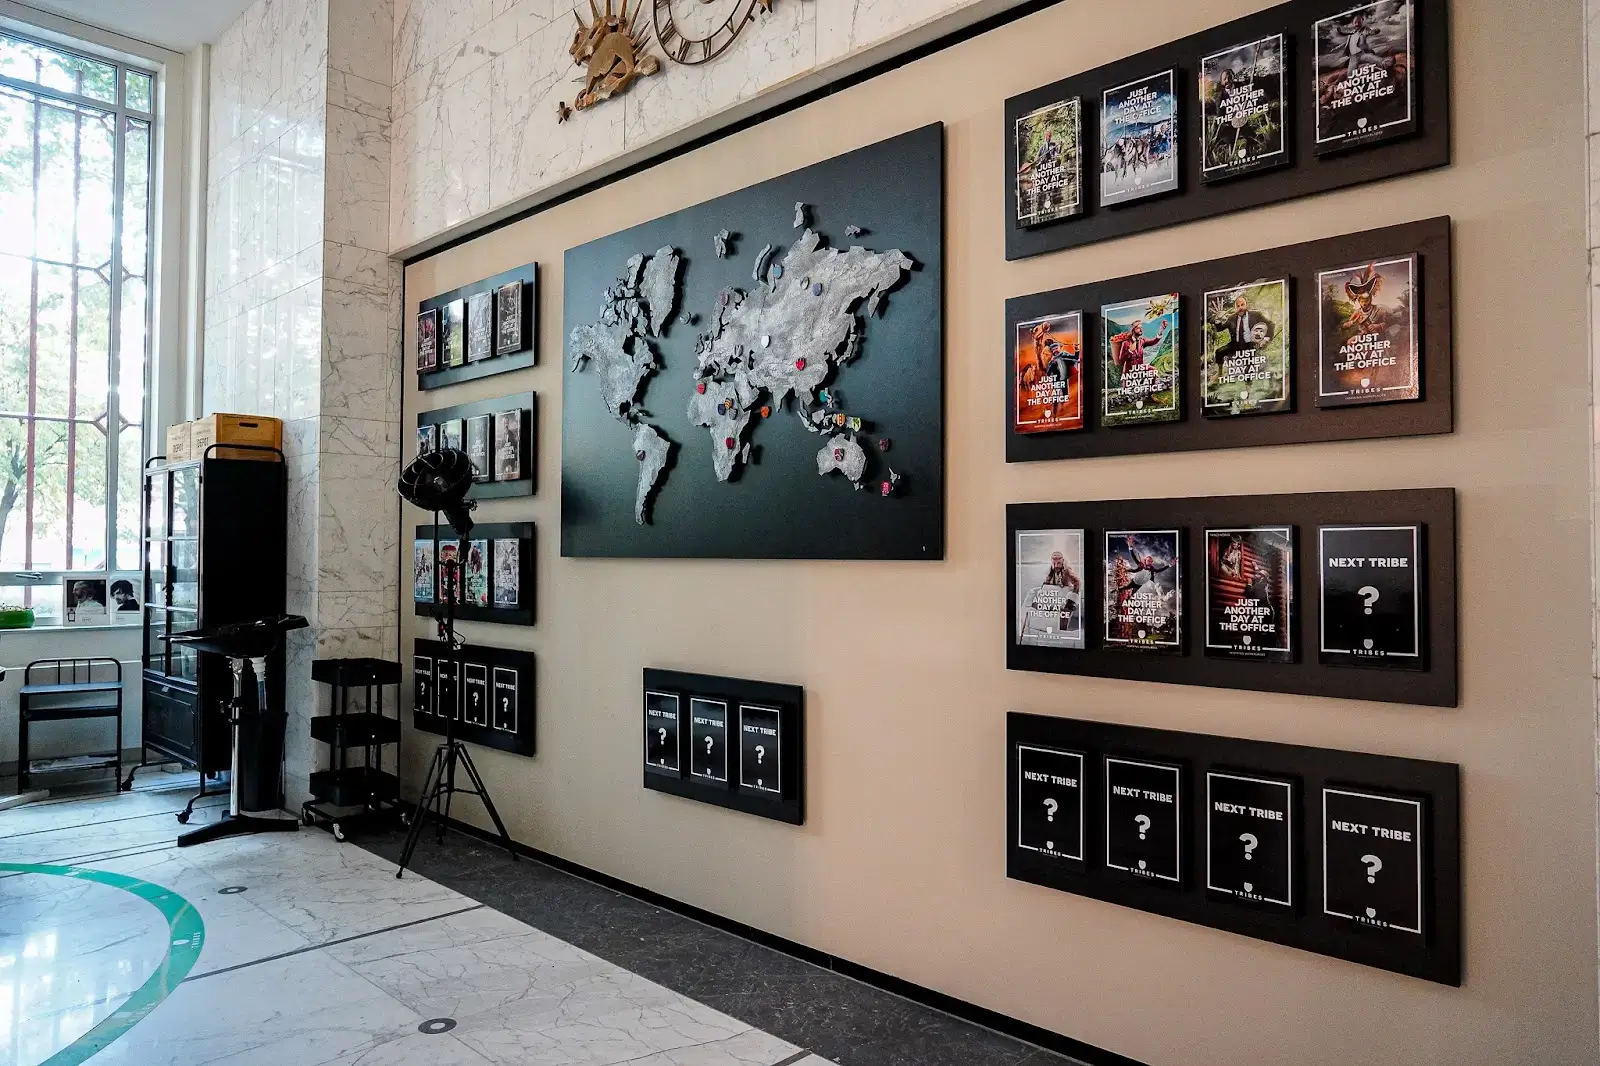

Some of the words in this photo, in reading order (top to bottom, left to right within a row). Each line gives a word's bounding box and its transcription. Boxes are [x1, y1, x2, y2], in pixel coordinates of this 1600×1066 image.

[1348, 64, 1376, 79] JUST
[1336, 70, 1388, 91] ANOTHER
[1127, 86, 1148, 99] JUST
[1229, 83, 1254, 96] JUST
[1344, 84, 1365, 97] DAY
[1367, 80, 1381, 91] AT
[1119, 92, 1157, 109] ANOTHER
[1220, 89, 1264, 108] ANOTHER
[1331, 96, 1352, 109] THE
[1354, 85, 1394, 102] OFFICE
[1124, 105, 1140, 115] DAY
[1142, 101, 1152, 109] AT
[1226, 102, 1244, 114] DAY
[1246, 98, 1258, 108] AT
[1114, 115, 1129, 124] THE
[1133, 105, 1161, 120] OFFICE
[1216, 113, 1233, 125] THE
[1235, 104, 1269, 118] OFFICE
[1038, 160, 1056, 171] JUST
[1030, 166, 1065, 180] ANOTHER
[1026, 186, 1040, 195] THE
[1042, 178, 1068, 191] OFFICE
[1035, 176, 1049, 186] DAY
[1051, 174, 1060, 182] AT
[1351, 333, 1379, 344] JUST
[1339, 340, 1390, 354] ANOTHER
[1232, 349, 1256, 359] JUST
[1346, 351, 1368, 361] DAY
[1370, 350, 1384, 359] AT
[1129, 364, 1150, 372] JUST
[1222, 356, 1266, 367] ANOTHER
[1334, 362, 1355, 371] THE
[1358, 357, 1396, 369] OFFICE
[1120, 370, 1159, 380] ANOTHER
[1228, 366, 1246, 375] DAY
[1248, 364, 1260, 373] AT
[1039, 374, 1058, 384] JUST
[1218, 375, 1235, 384] THE
[1237, 372, 1271, 382] OFFICE
[1030, 381, 1065, 391] ANOTHER
[1134, 384, 1163, 393] OFFICE
[1036, 390, 1050, 398] DAY
[1043, 395, 1069, 404] OFFICE
[1329, 558, 1365, 568] NEXT
[1368, 558, 1408, 568] TRIBE
[1122, 600, 1162, 608] ANOTHER
[1358, 586, 1380, 615] ?
[1224, 606, 1270, 615] ANOTHER
[1118, 614, 1135, 623] THE
[1136, 615, 1166, 624] OFFICE
[1231, 615, 1250, 623] DAY
[1251, 615, 1264, 624] AT
[1219, 622, 1238, 631] THE
[1240, 623, 1275, 632] OFFICE
[662, 711, 676, 720] TRIBE
[694, 717, 708, 725] NEXT
[709, 719, 724, 728] TRIBE
[658, 728, 667, 745] ?
[743, 725, 759, 733] NEXT
[760, 727, 776, 736] TRIBE
[704, 736, 713, 754] ?
[755, 745, 765, 764] ?
[1025, 771, 1049, 782] NEXT
[1051, 775, 1077, 788] TRIBE
[1113, 786, 1140, 798] NEXT
[1143, 790, 1172, 803] TRIBE
[1043, 798, 1058, 822] ?
[1215, 802, 1246, 815] NEXT
[1249, 807, 1283, 821] TRIBE
[1134, 814, 1150, 840] ?
[1332, 820, 1368, 834] NEXT
[1372, 826, 1411, 842] TRIBE
[1239, 833, 1258, 860] ?
[1361, 854, 1382, 884] ?
[1355, 915, 1387, 927] TRIBES
